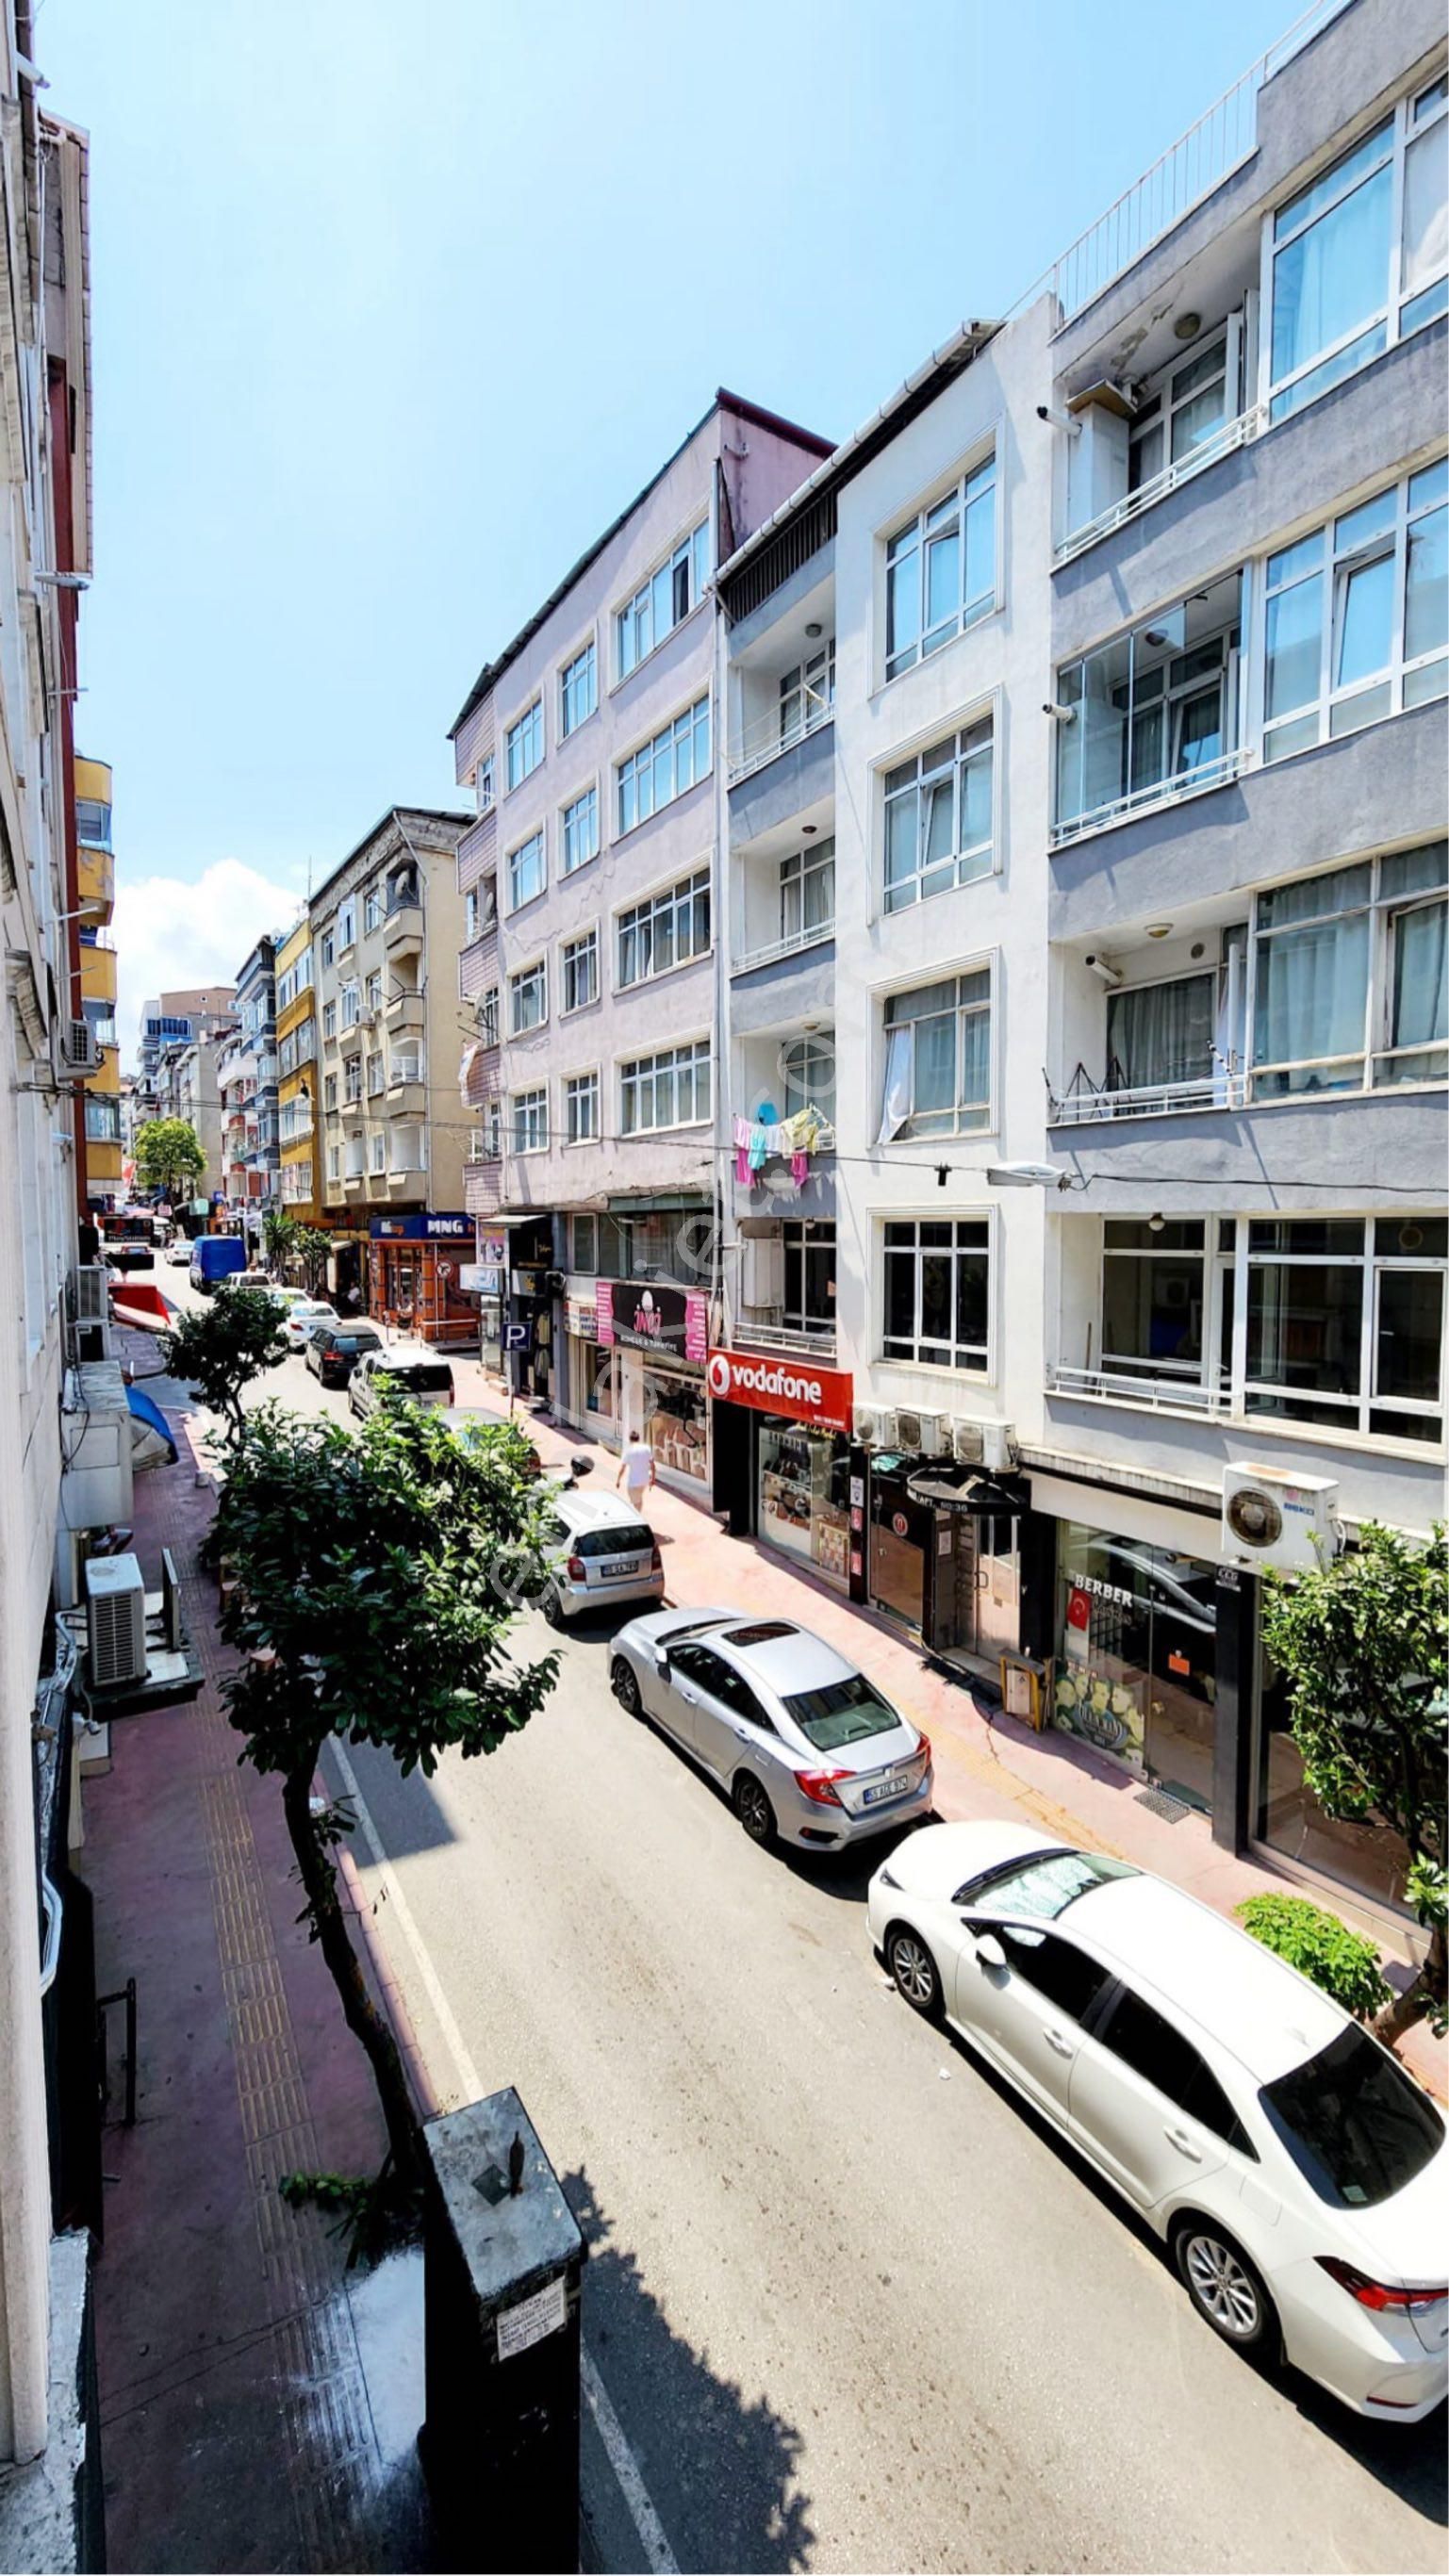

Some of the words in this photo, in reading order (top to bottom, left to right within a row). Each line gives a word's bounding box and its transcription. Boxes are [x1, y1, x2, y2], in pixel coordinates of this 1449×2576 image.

[427, 1220, 464, 1234] MNG
[505, 1324, 526, 1350] P
[732, 1364, 822, 1405] vodafone
[1075, 1573, 1133, 1608] BERBER
